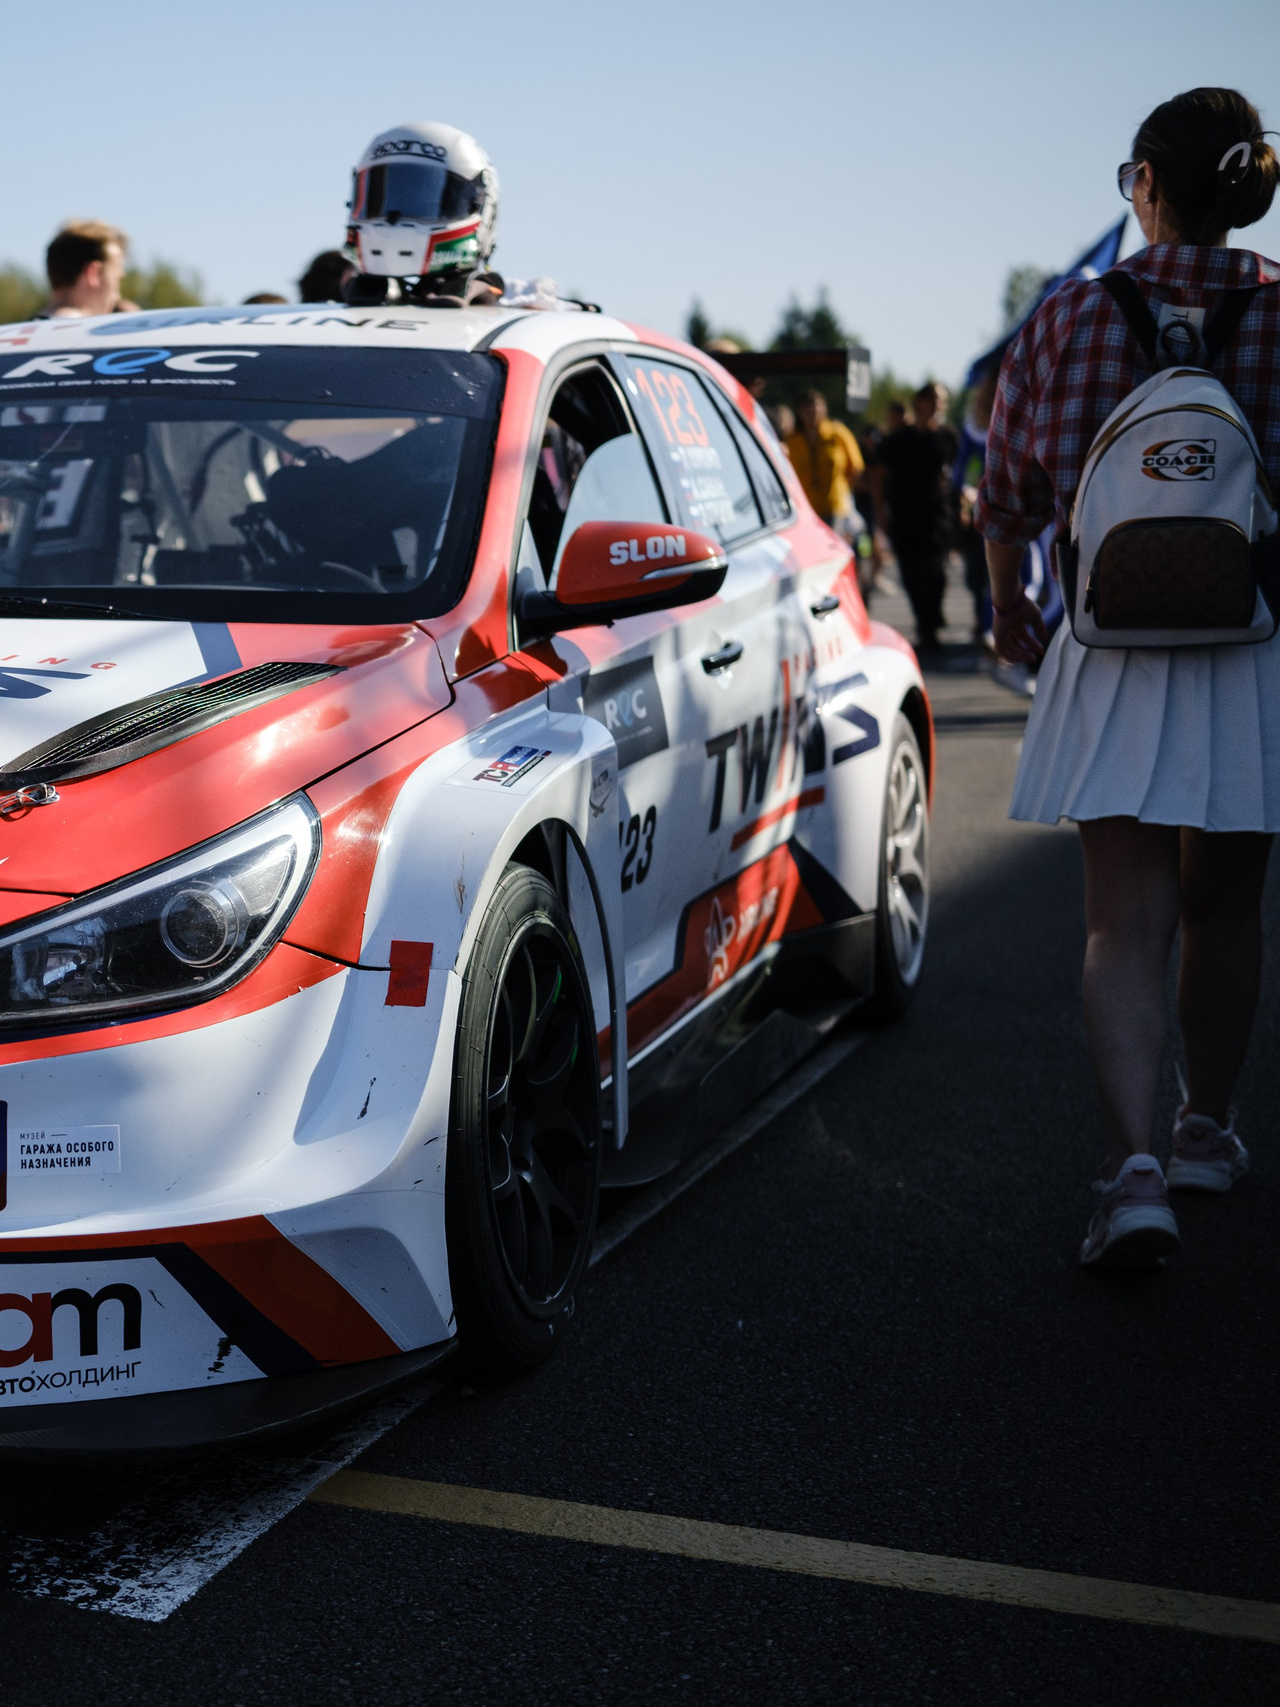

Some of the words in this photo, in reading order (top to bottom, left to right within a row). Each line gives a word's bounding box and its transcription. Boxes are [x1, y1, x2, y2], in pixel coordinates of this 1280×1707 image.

[372, 139, 447, 159] sparco
[635, 366, 710, 448] 123
[1142, 455, 1216, 467] COACH
[609, 534, 686, 566] SLON
[472, 760, 520, 783] TCR
[20, 1131, 46, 1140] МУЗЕЙ
[20, 1143, 62, 1155] ГАРАЖА
[66, 1141, 114, 1153] ОСОБОГО
[21, 1156, 91, 1169] НАЗНАЧЕНИЯ
